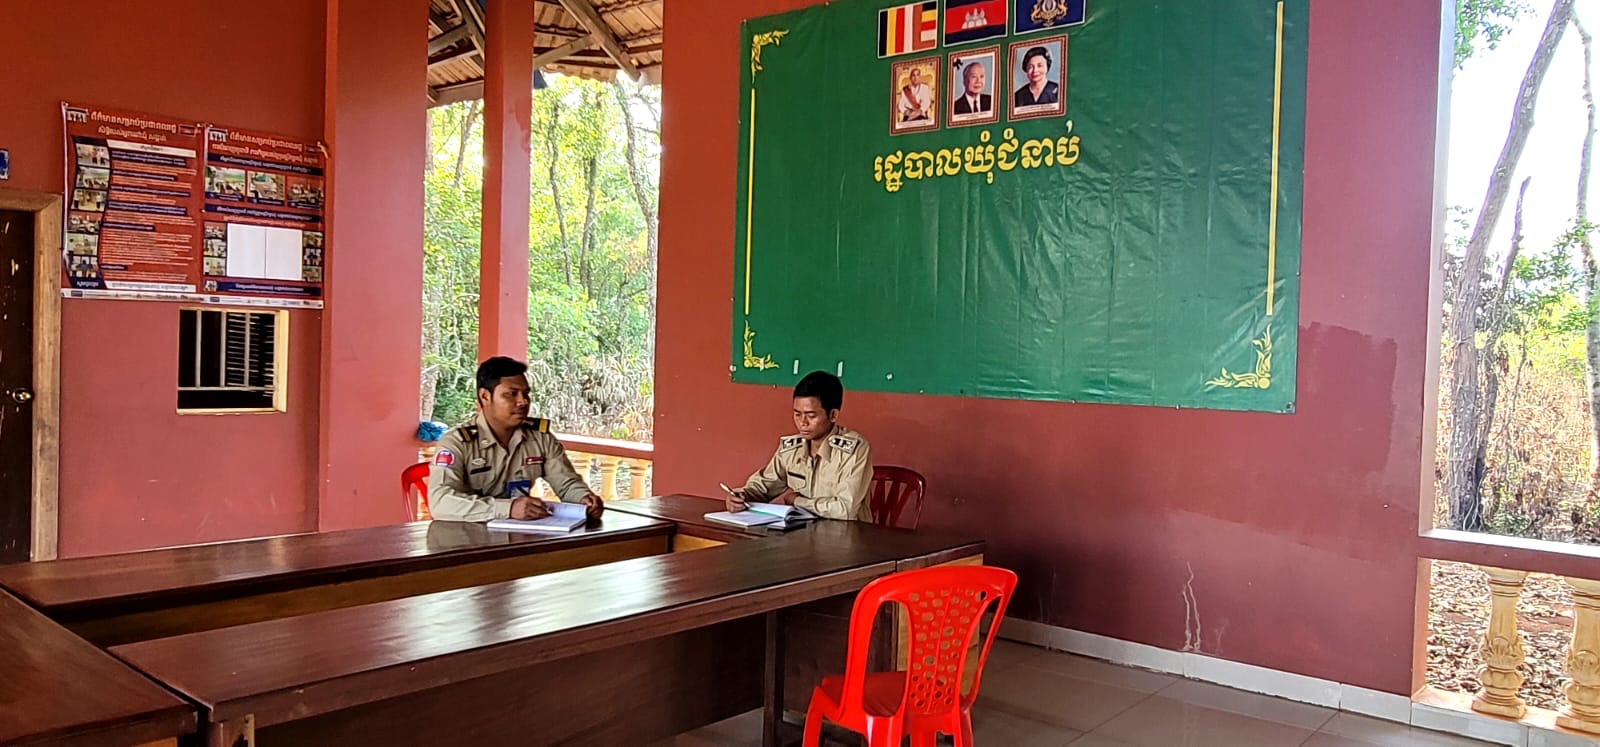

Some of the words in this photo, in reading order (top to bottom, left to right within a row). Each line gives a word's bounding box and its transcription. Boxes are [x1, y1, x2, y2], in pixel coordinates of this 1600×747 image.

[873, 120, 1081, 193] រដ្ឋបាលឃុំជំនាប់
